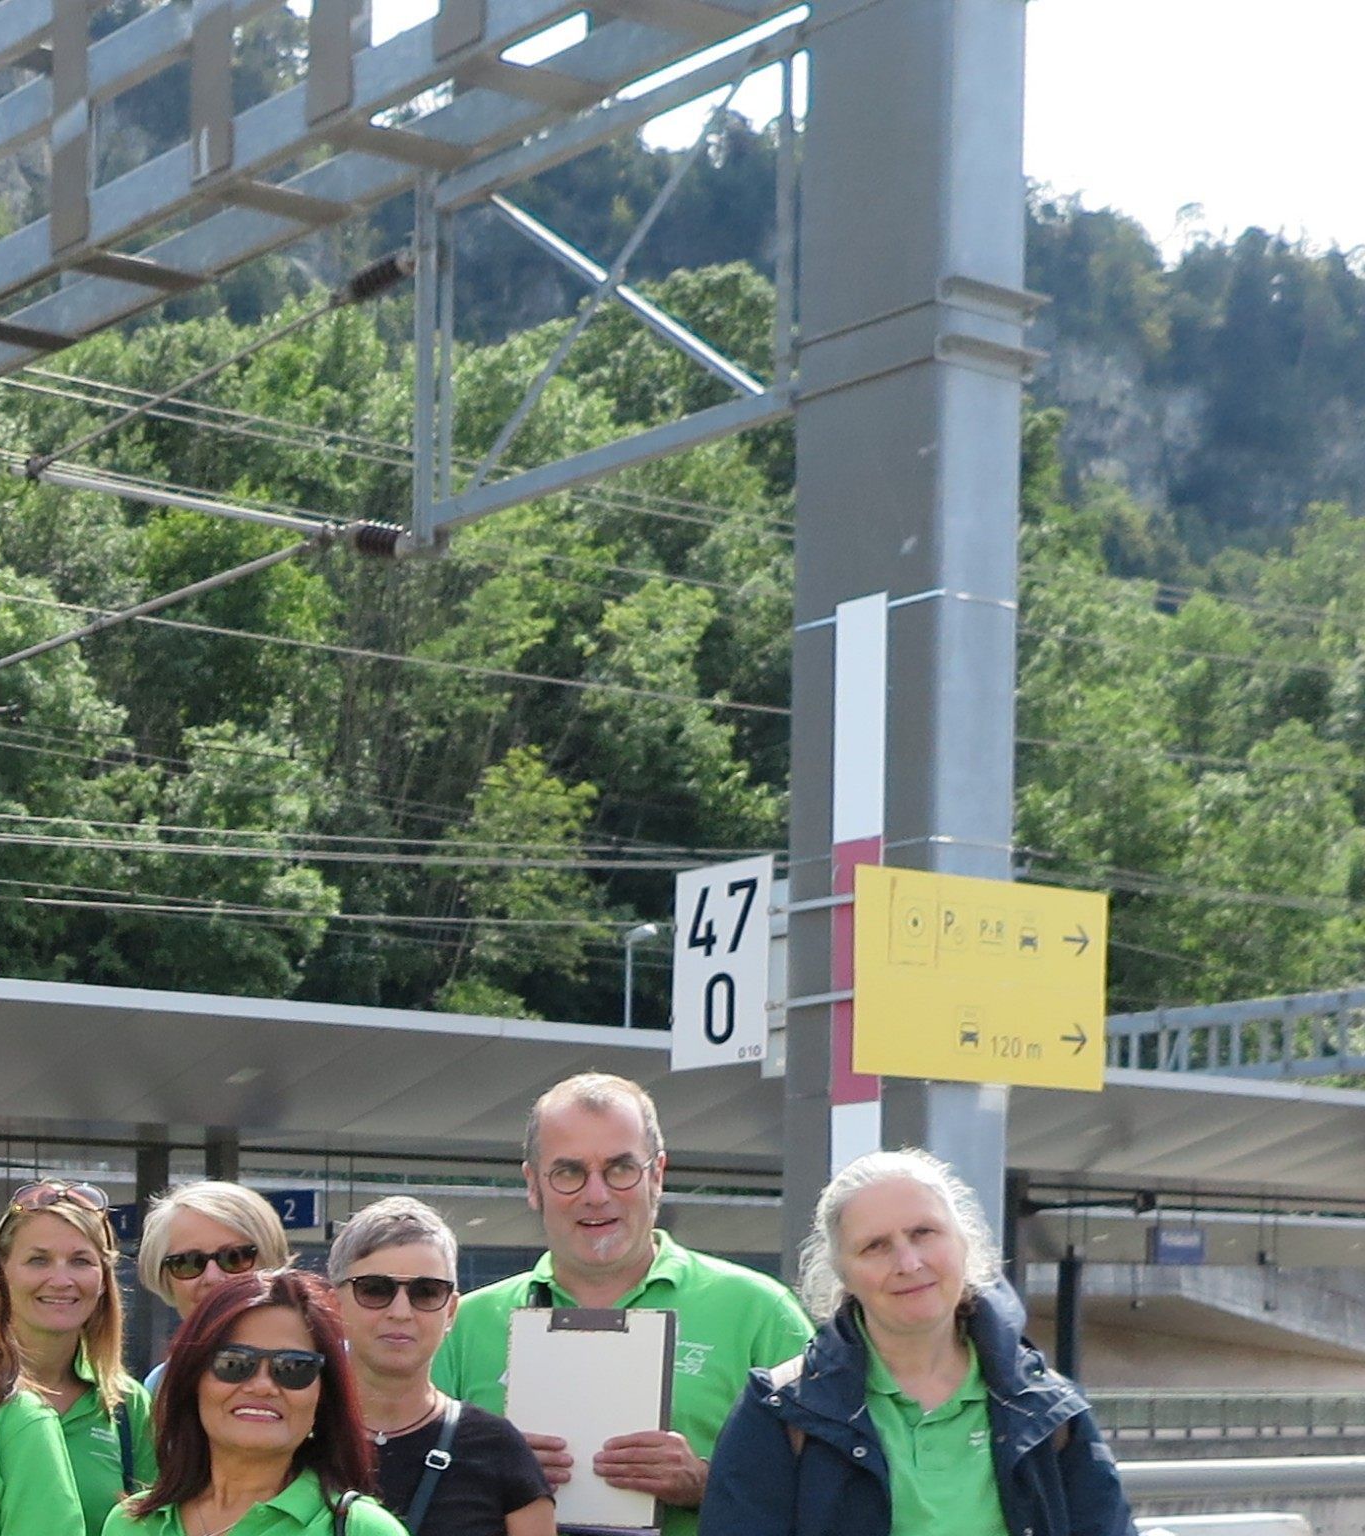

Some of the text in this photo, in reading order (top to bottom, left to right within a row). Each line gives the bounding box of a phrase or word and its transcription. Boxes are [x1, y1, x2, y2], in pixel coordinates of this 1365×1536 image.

[687, 876, 759, 958] 47
[703, 971, 736, 1046] 0
[990, 1035, 1044, 1060] 120 m
[283, 1198, 296, 1221] 2
